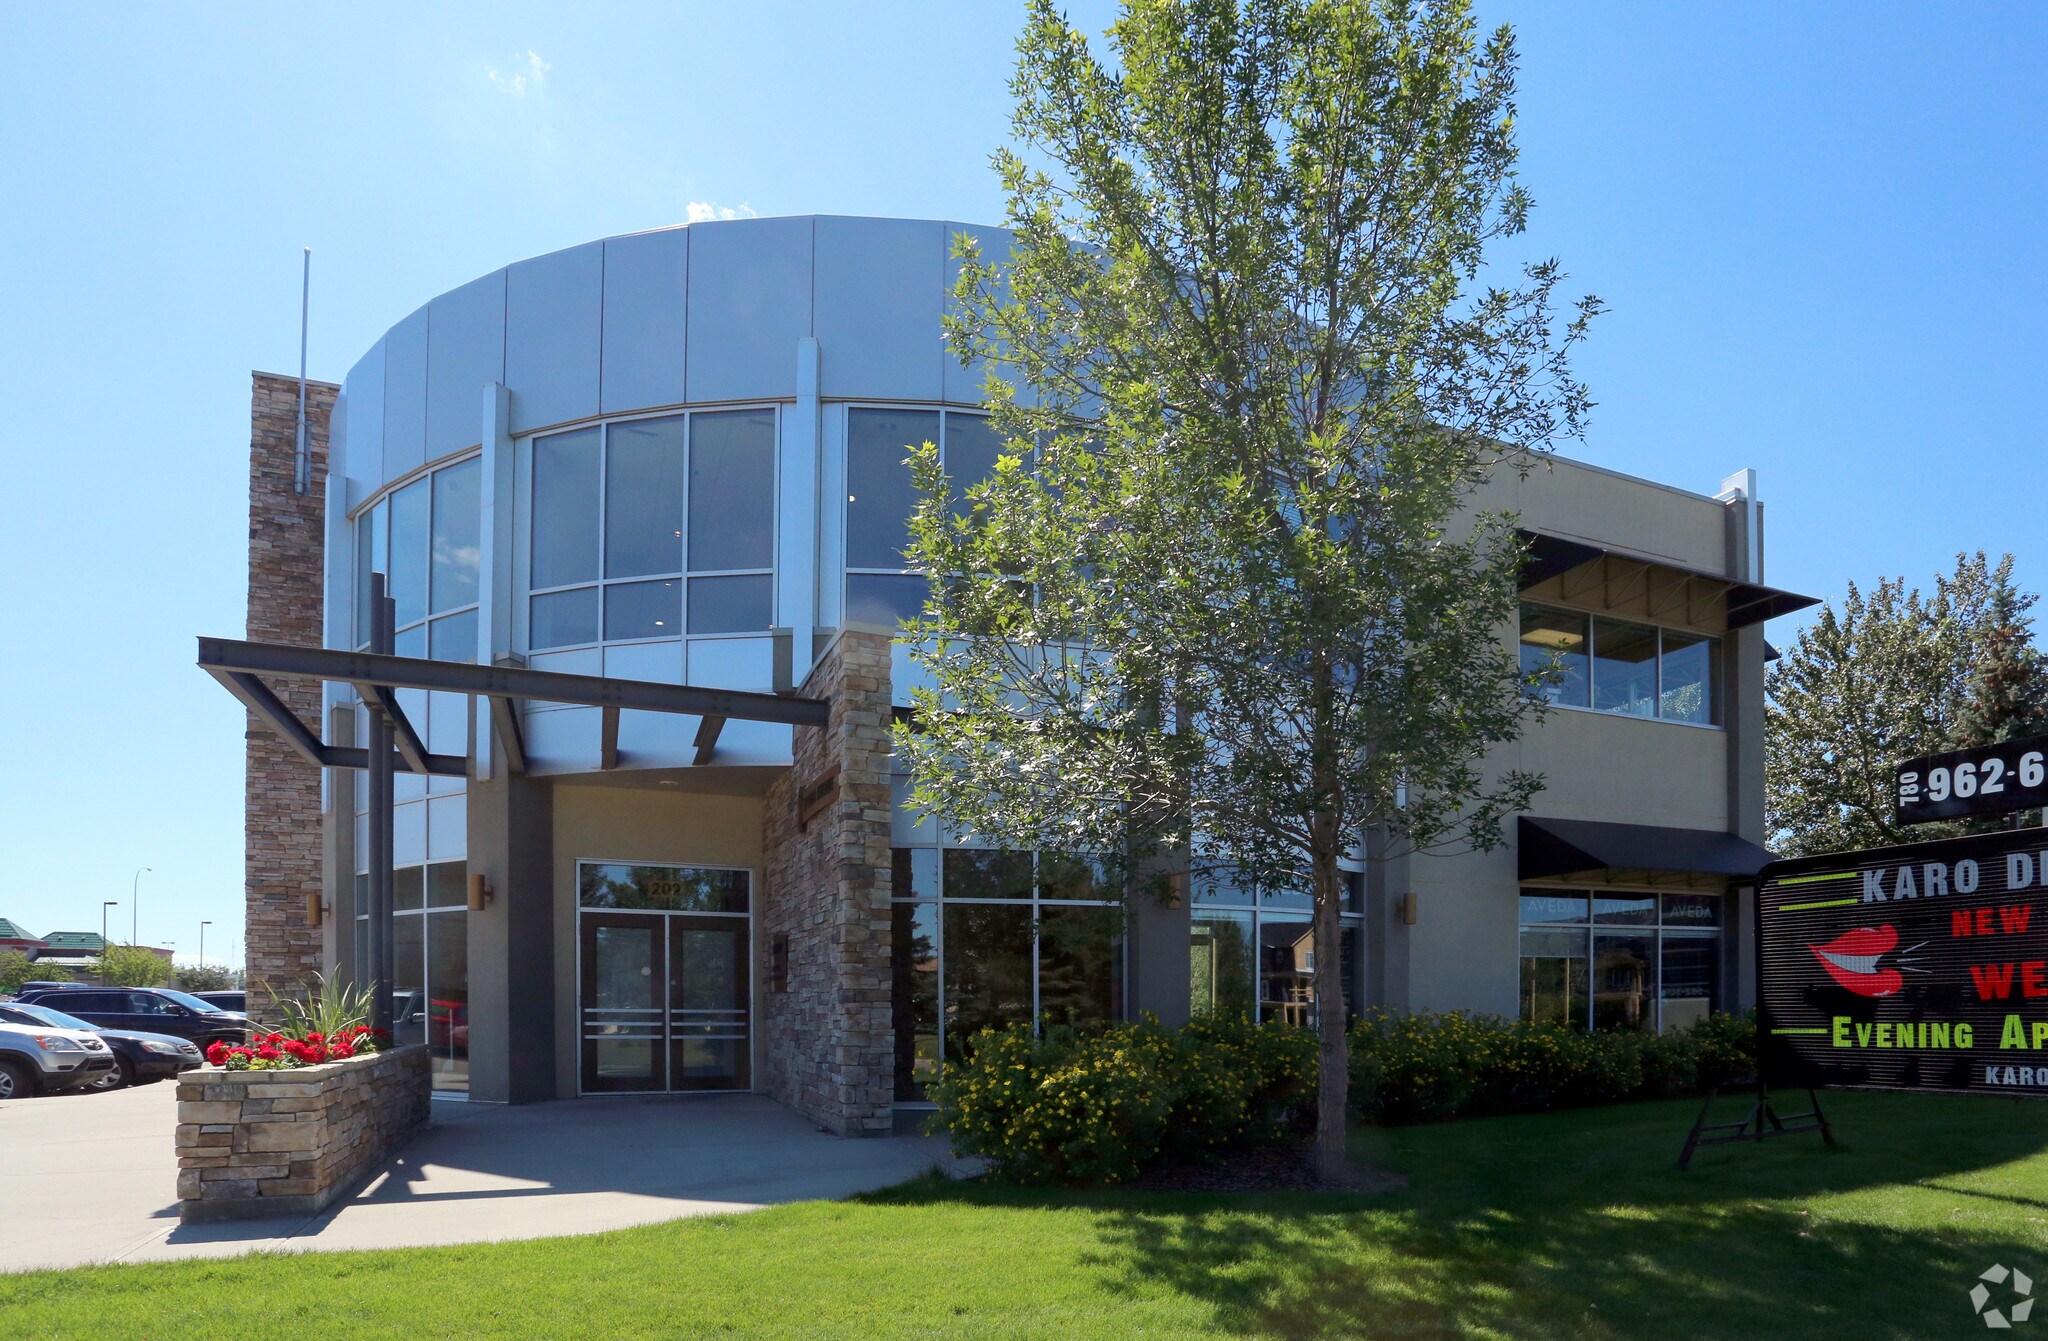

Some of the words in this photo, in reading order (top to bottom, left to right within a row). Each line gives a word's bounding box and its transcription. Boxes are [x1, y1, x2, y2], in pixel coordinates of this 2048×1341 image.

[1862, 859, 1980, 903] KARO
[1528, 898, 1576, 913] AVEDA
[1603, 901, 1648, 916] AVEDA
[1670, 905, 1712, 918] AVEDA
[1951, 905, 2032, 937] NEW
[1985, 1066, 2048, 1086] KARO
